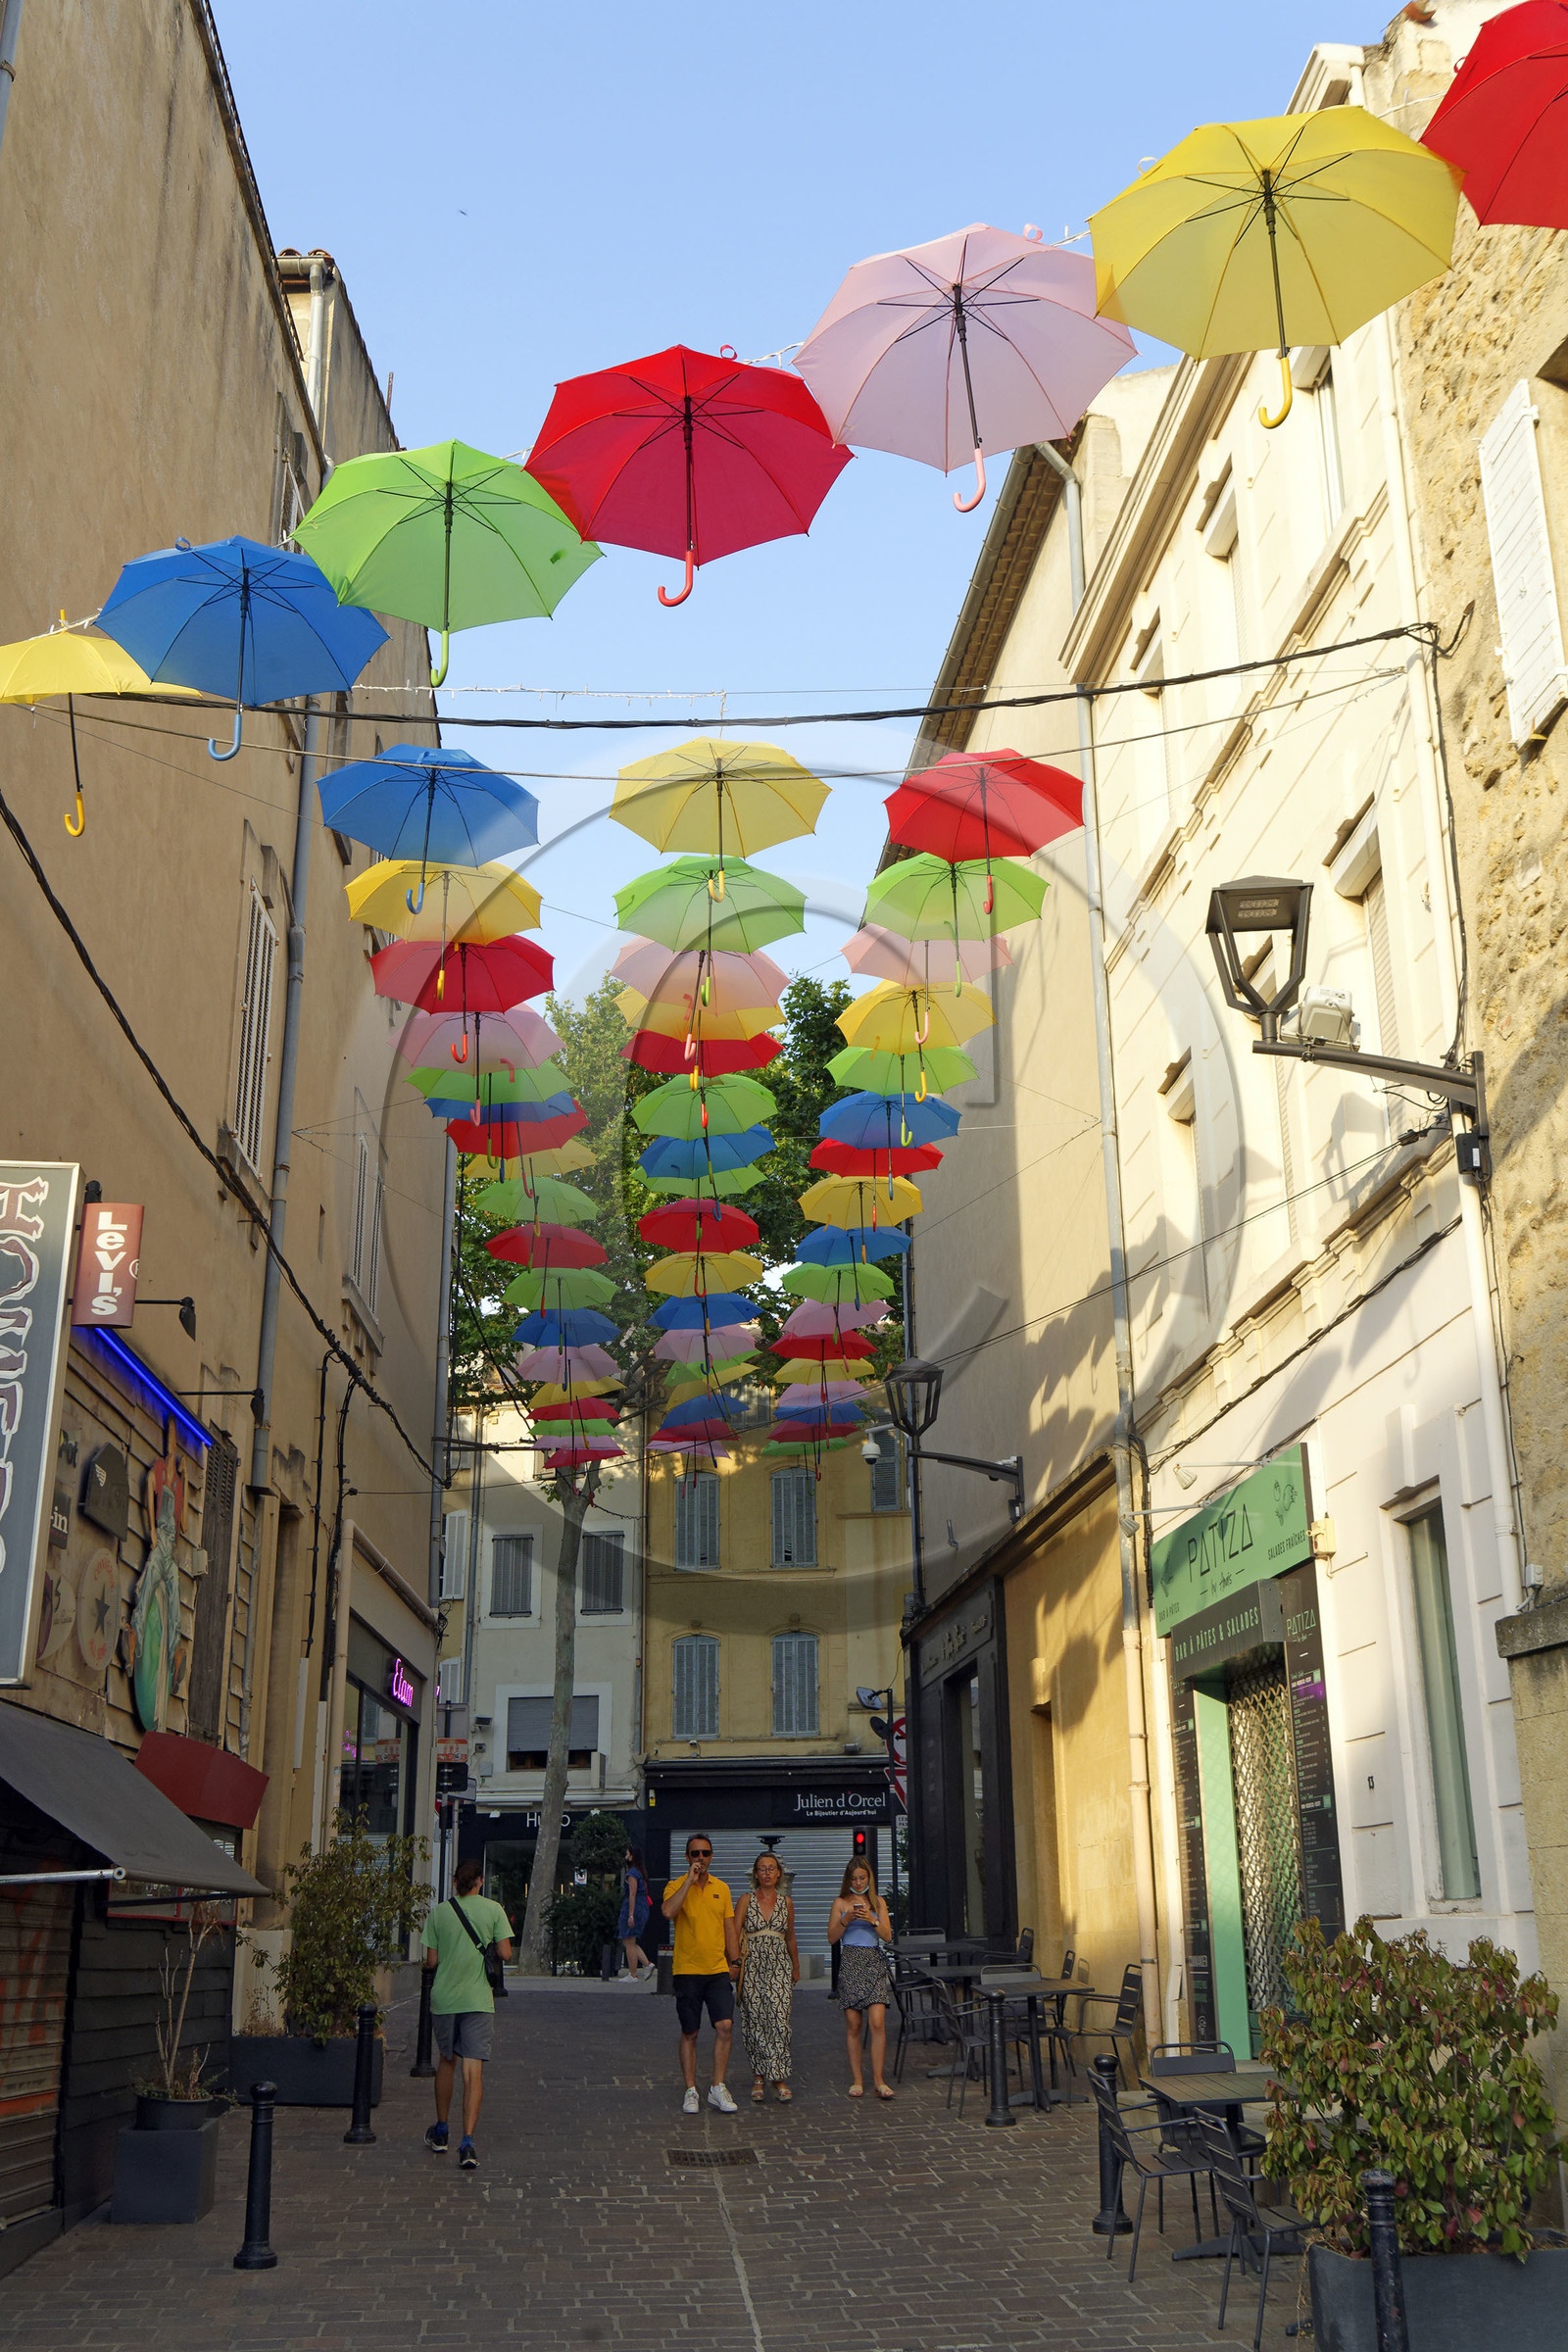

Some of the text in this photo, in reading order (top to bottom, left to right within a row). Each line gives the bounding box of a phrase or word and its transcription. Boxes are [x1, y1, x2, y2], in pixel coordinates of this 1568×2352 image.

[1187, 1502, 1253, 1584] PATIZA
[1175, 1606, 1259, 1662] BAR À PÂTES & SALADES
[1286, 1608, 1317, 1639] PATIZA
[392, 1657, 414, 1707] Etam
[526, 1812, 571, 1828] HO
[794, 1793, 834, 1812] Julien
